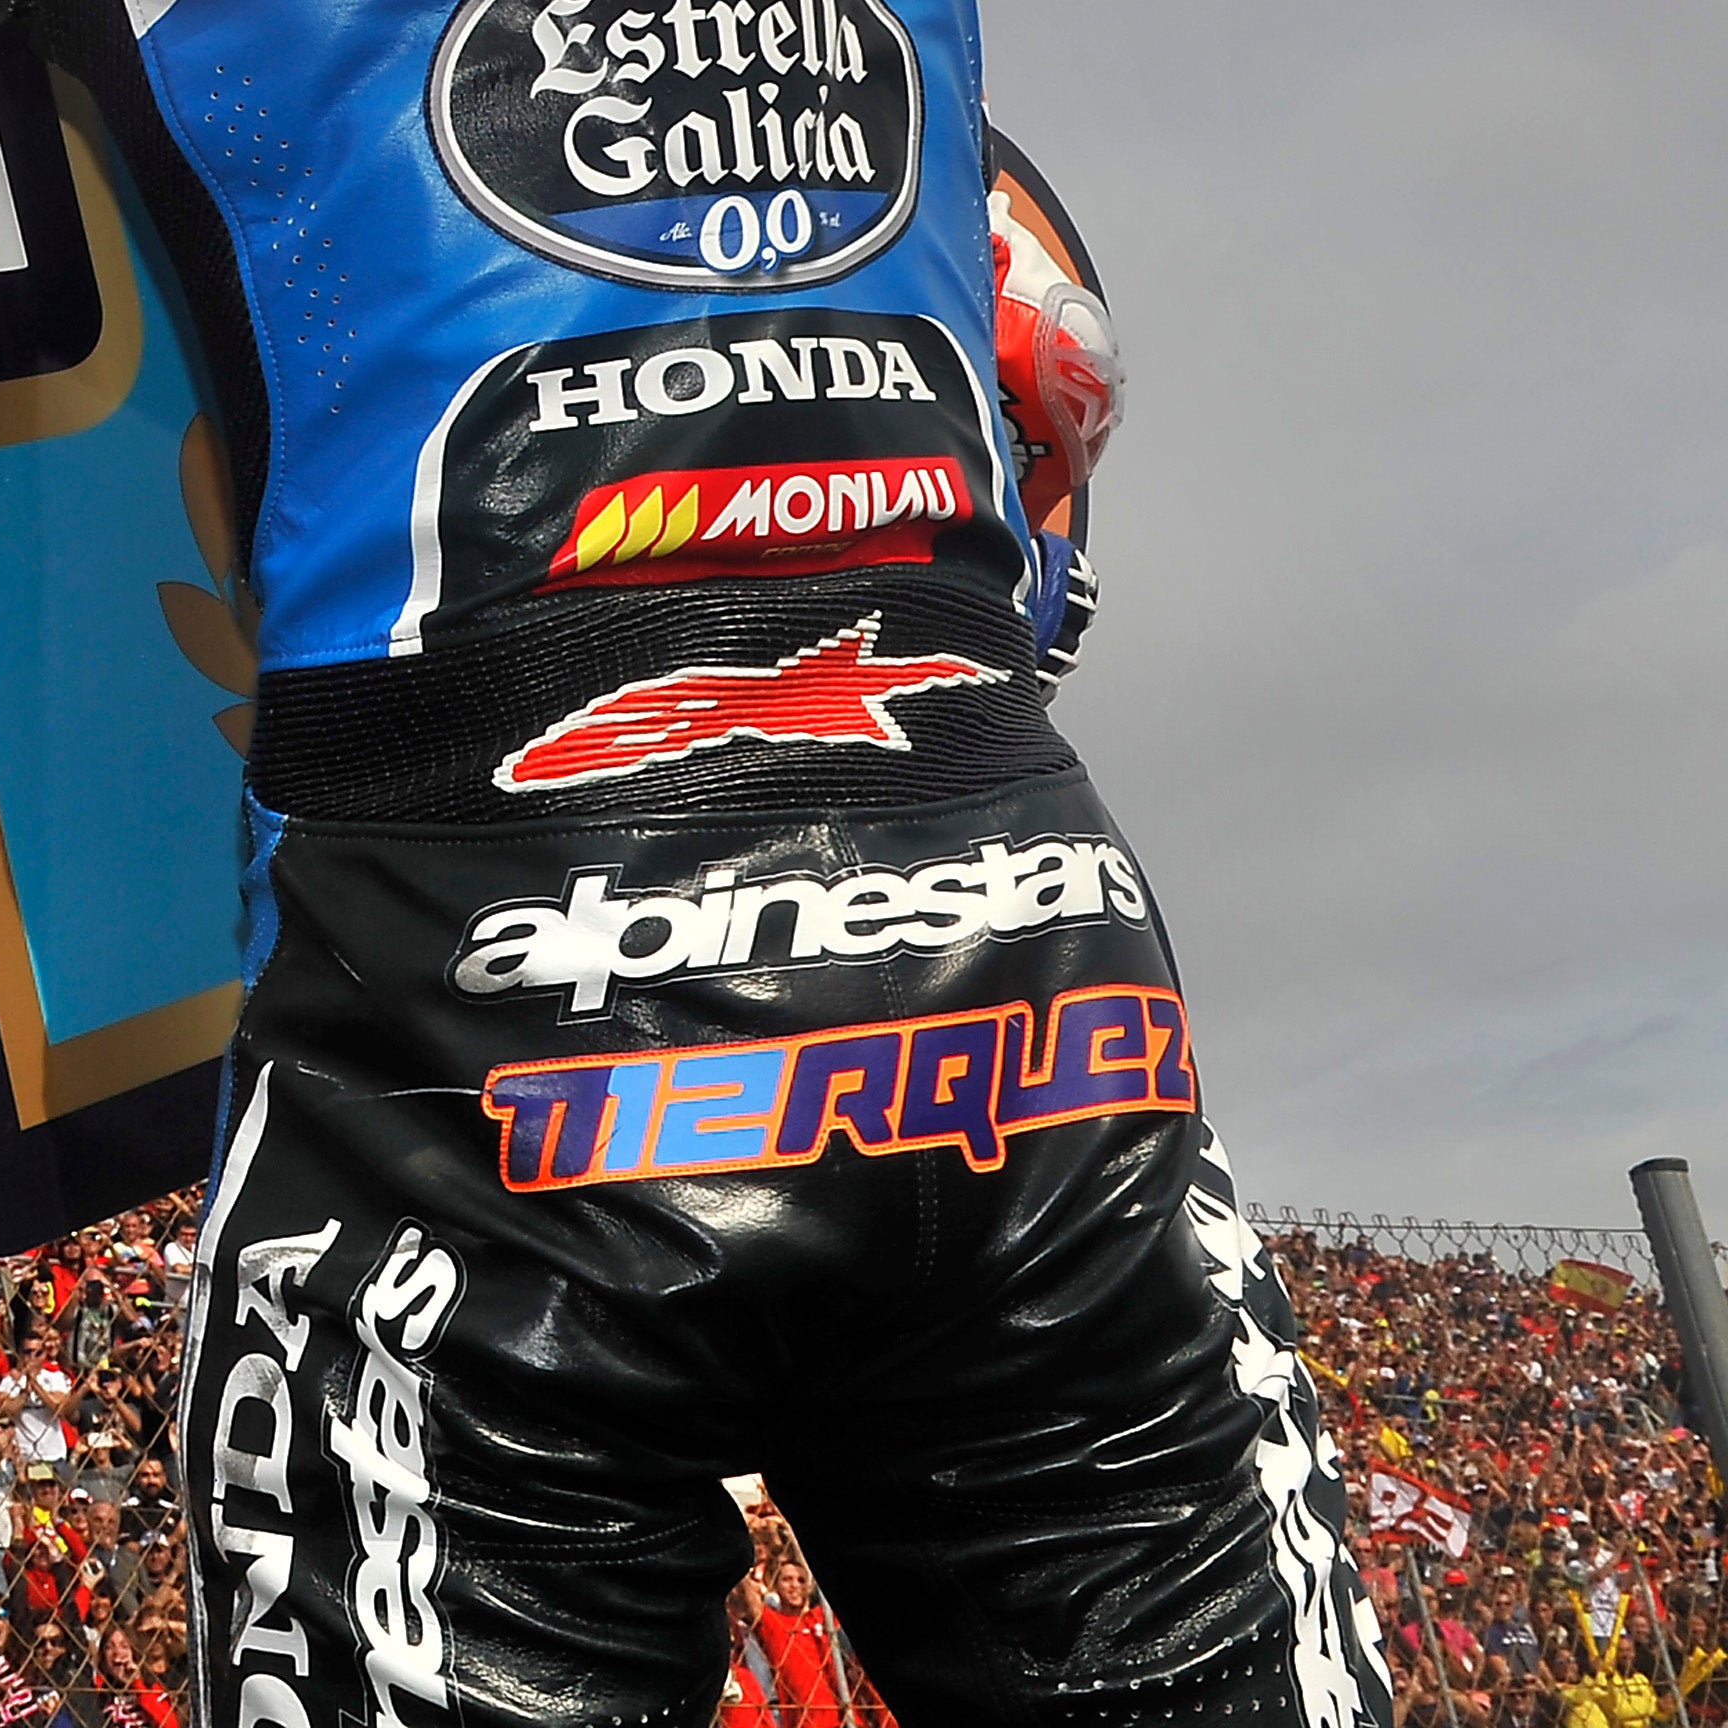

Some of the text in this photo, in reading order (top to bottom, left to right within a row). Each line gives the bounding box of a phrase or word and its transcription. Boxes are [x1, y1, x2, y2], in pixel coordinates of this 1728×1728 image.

[563, 83, 876, 196] Galicia
[526, 337, 937, 432] HONDA
[454, 840, 1148, 1012] alpinestars
